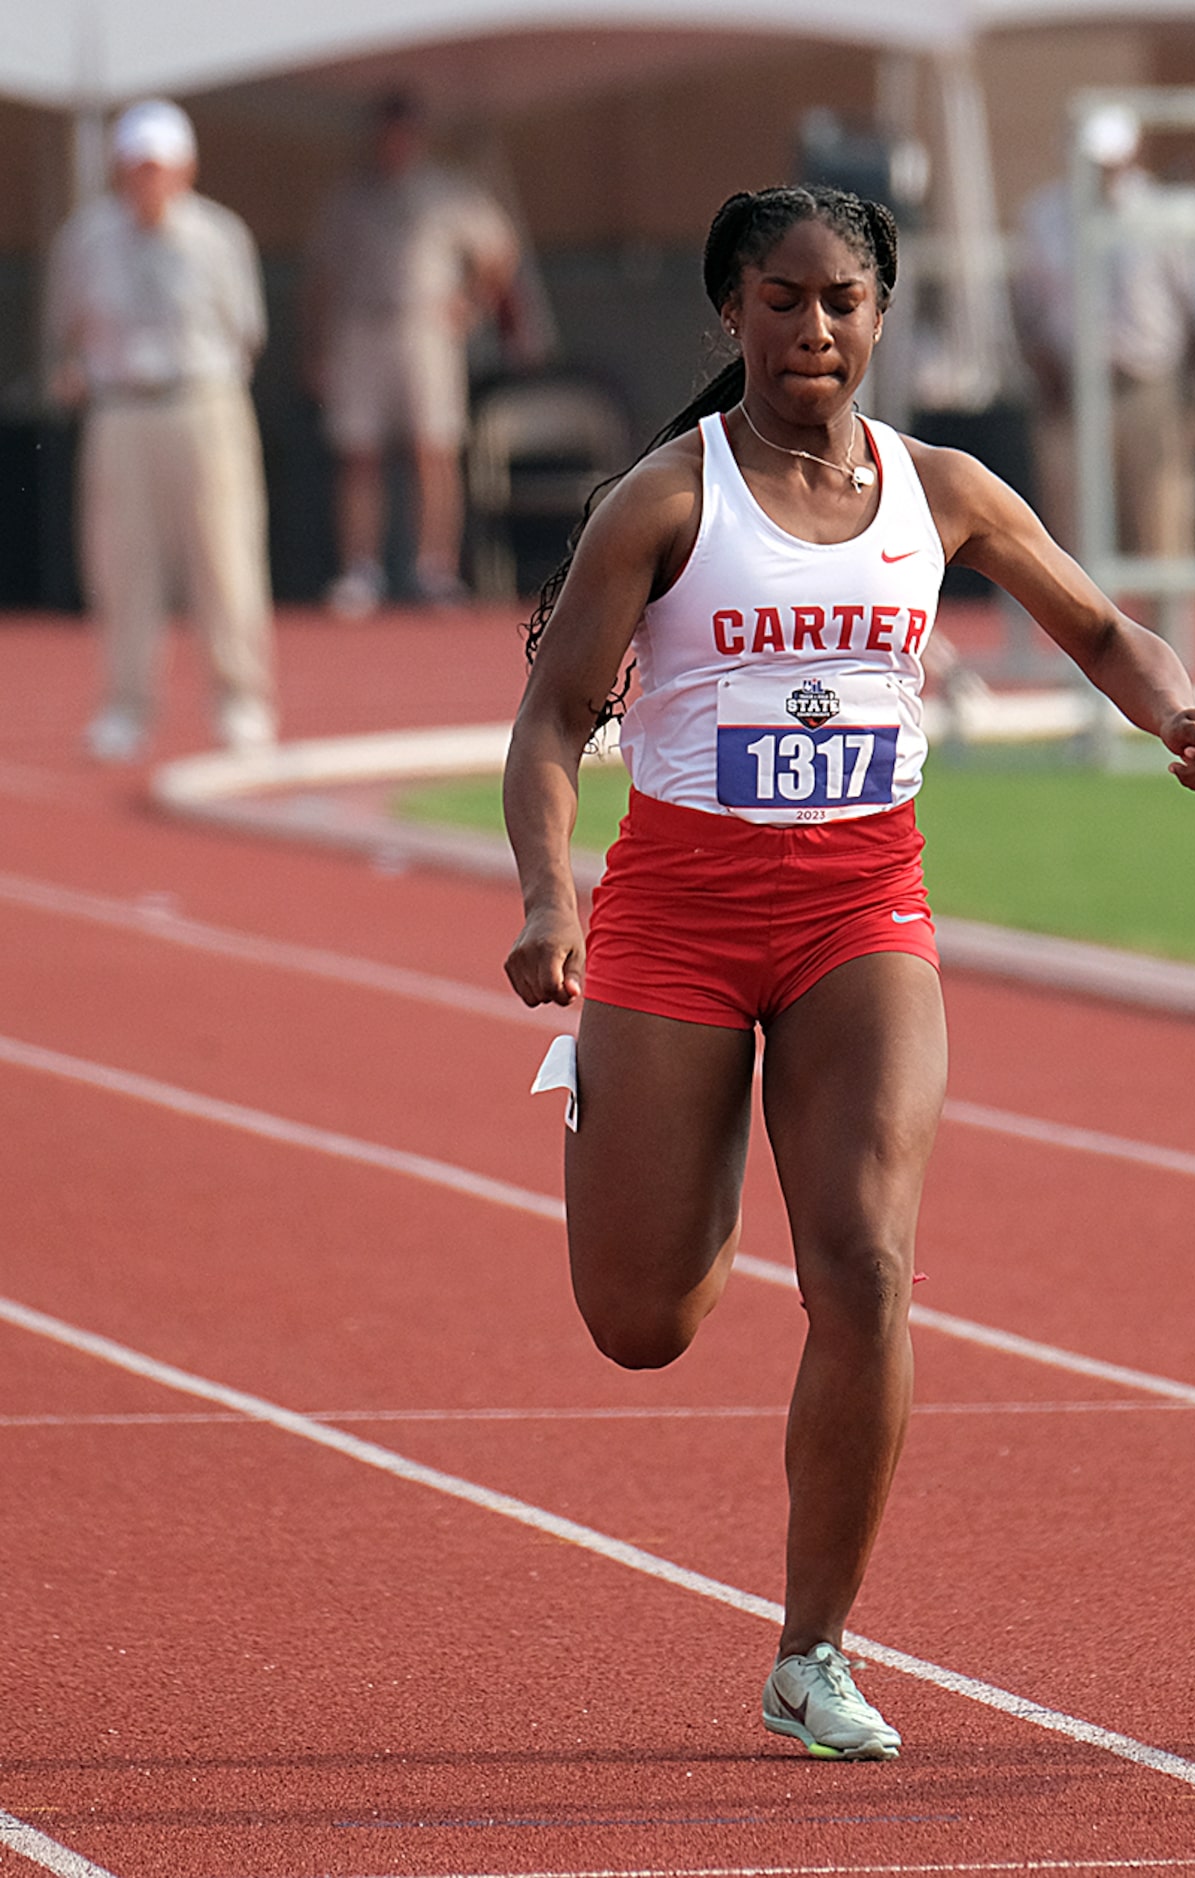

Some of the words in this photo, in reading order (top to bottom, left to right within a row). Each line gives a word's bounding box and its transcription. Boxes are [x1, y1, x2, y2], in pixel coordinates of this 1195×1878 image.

[712, 605, 927, 656] CARTER
[787, 700, 839, 713] STATE
[747, 733, 875, 801] 1317
[796, 810, 826, 820] 2023
